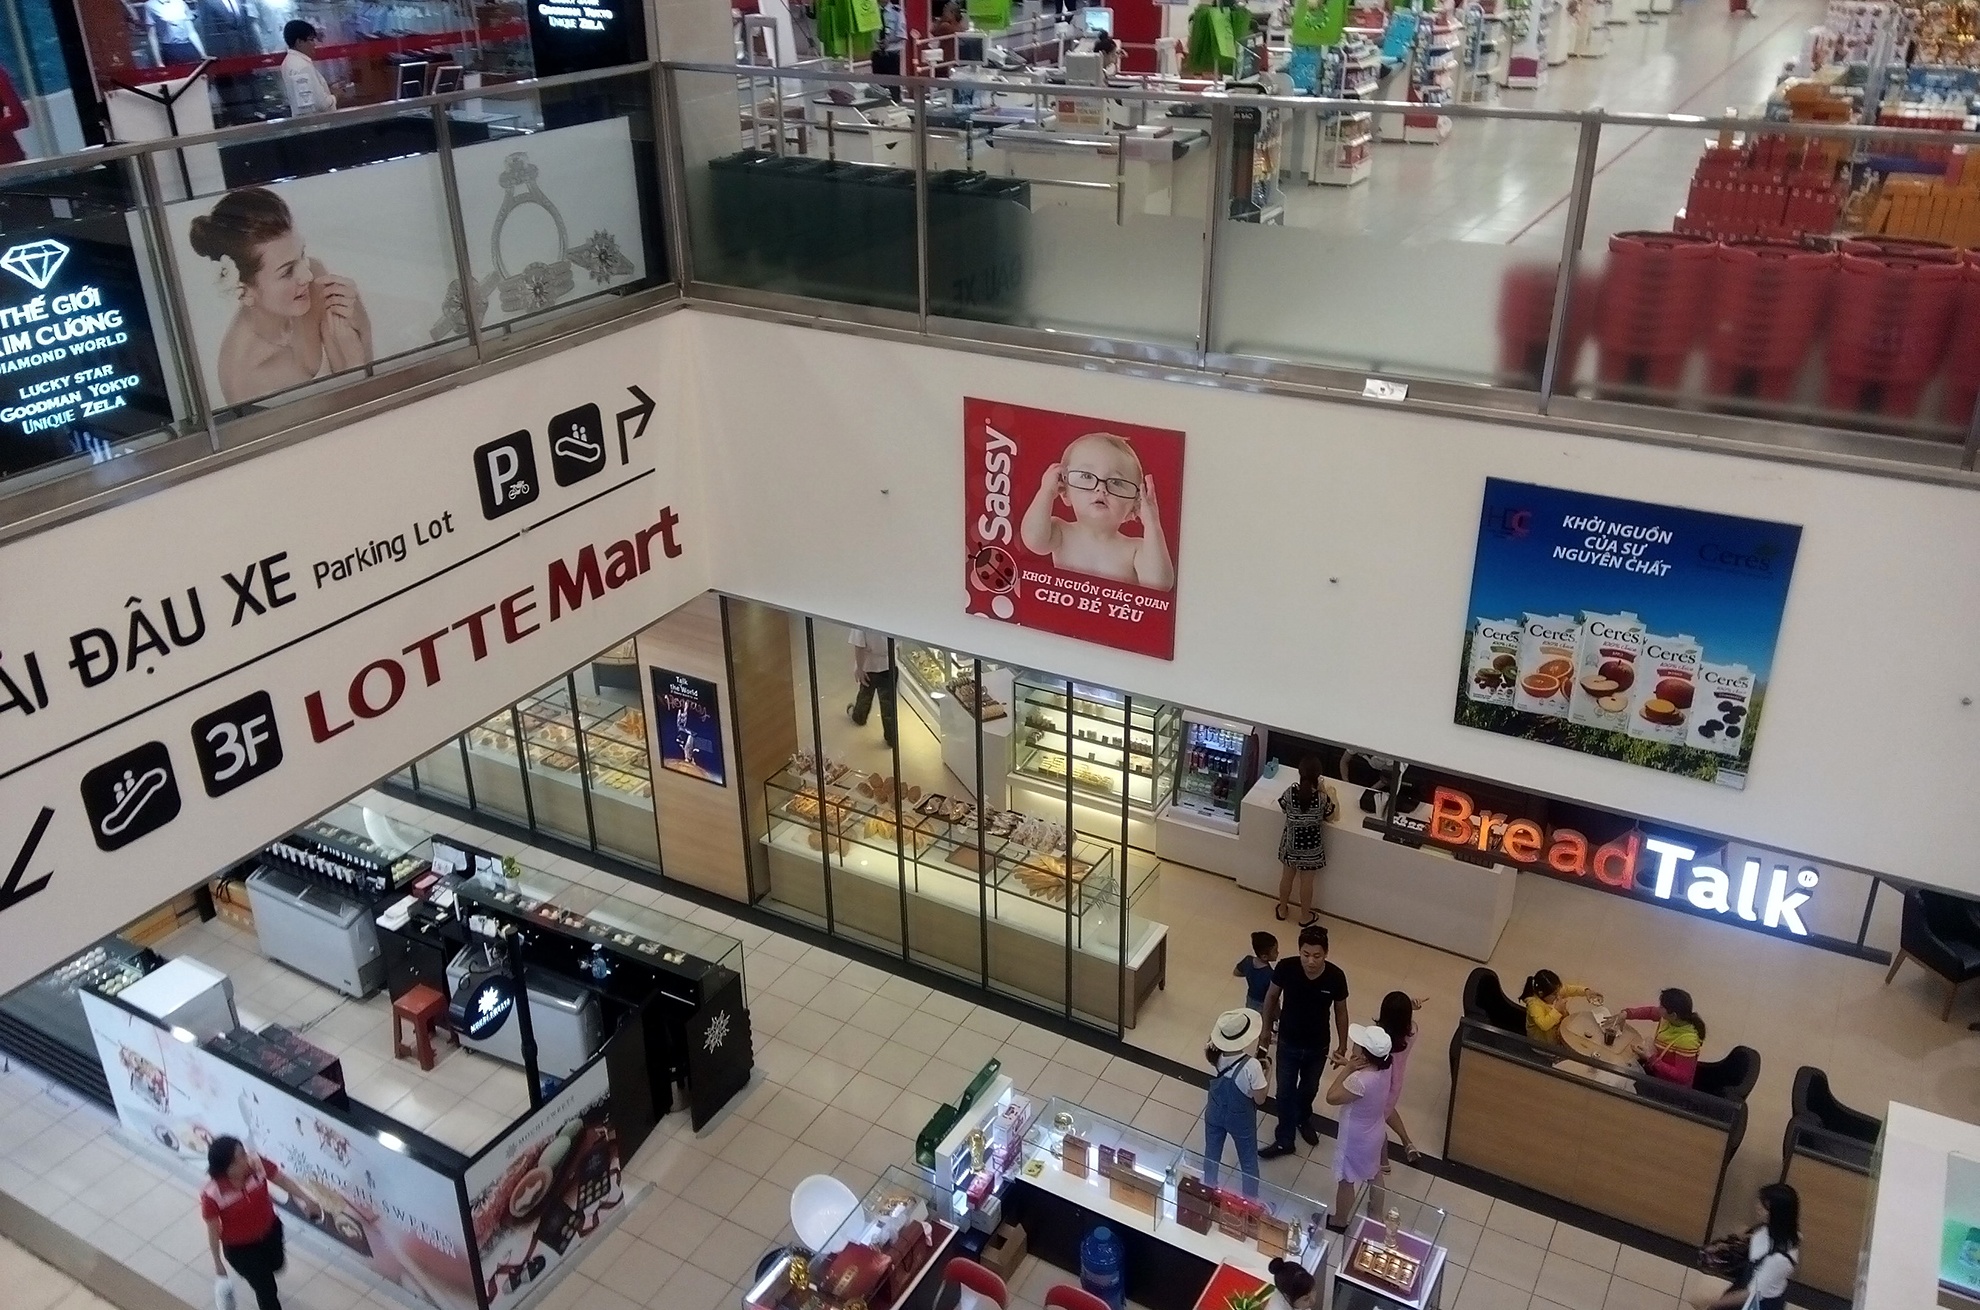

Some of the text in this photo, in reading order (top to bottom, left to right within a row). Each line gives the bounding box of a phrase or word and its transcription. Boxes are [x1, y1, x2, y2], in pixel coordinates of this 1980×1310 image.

[52, 285, 101, 315] GIỚI
[0, 310, 123, 357] IM CƯƠNG
[68, 332, 128, 357] WORLD
[18, 364, 114, 400] LUCKY STAR
[80, 395, 127, 418] ZELA
[978, 424, 1018, 546] Sassy
[1562, 514, 1673, 545] KHỞI NGUỒN
[1584, 532, 1618, 554] CỦA
[68, 587, 206, 688] ĐẬU
[220, 550, 297, 628] XE
[312, 533, 407, 589] Parking
[413, 510, 455, 546] Lot
[487, 445, 519, 507] P
[1552, 545, 1624, 570] NGUYÊN
[1625, 557, 1672, 578] CHẤT
[1034, 588, 1145, 623] CHO BÉ YÊU
[1101, 584, 1133, 603] GIÁC
[1135, 594, 1170, 612] QUAN
[1482, 627, 1520, 643] Ceres
[1530, 624, 1576, 642] Ceres
[1590, 621, 1640, 645] Ceres
[1647, 645, 1697, 665] Ceres
[1704, 671, 1749, 689] Ceres
[204, 713, 271, 782] 3F
[315, 1164, 374, 1204] MOCHI
[381, 1199, 455, 1249] SWEETS
